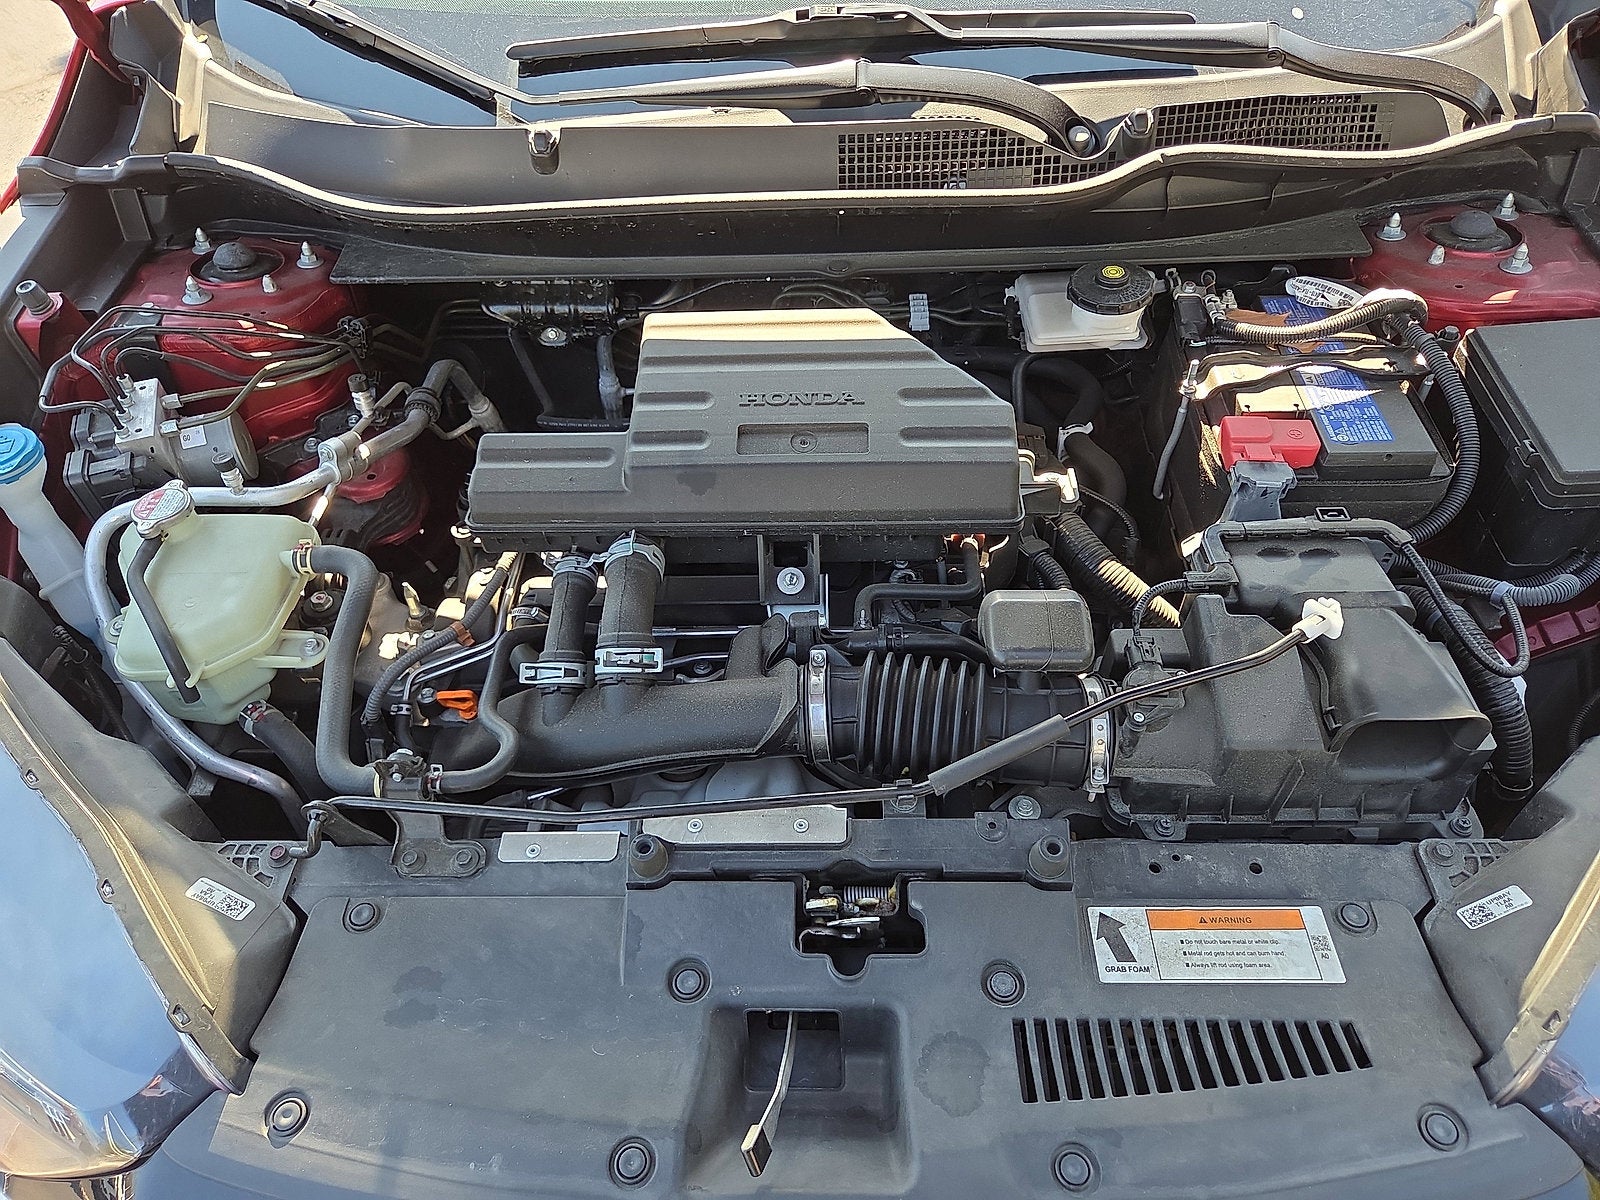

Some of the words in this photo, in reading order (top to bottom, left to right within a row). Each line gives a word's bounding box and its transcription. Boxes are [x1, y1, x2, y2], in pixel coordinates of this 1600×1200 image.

[739, 391, 865, 407] HONDA
[1208, 916, 1252, 924] WARNING
[1104, 965, 1127, 974] GRAB
[1128, 965, 1151, 974] FOAM
